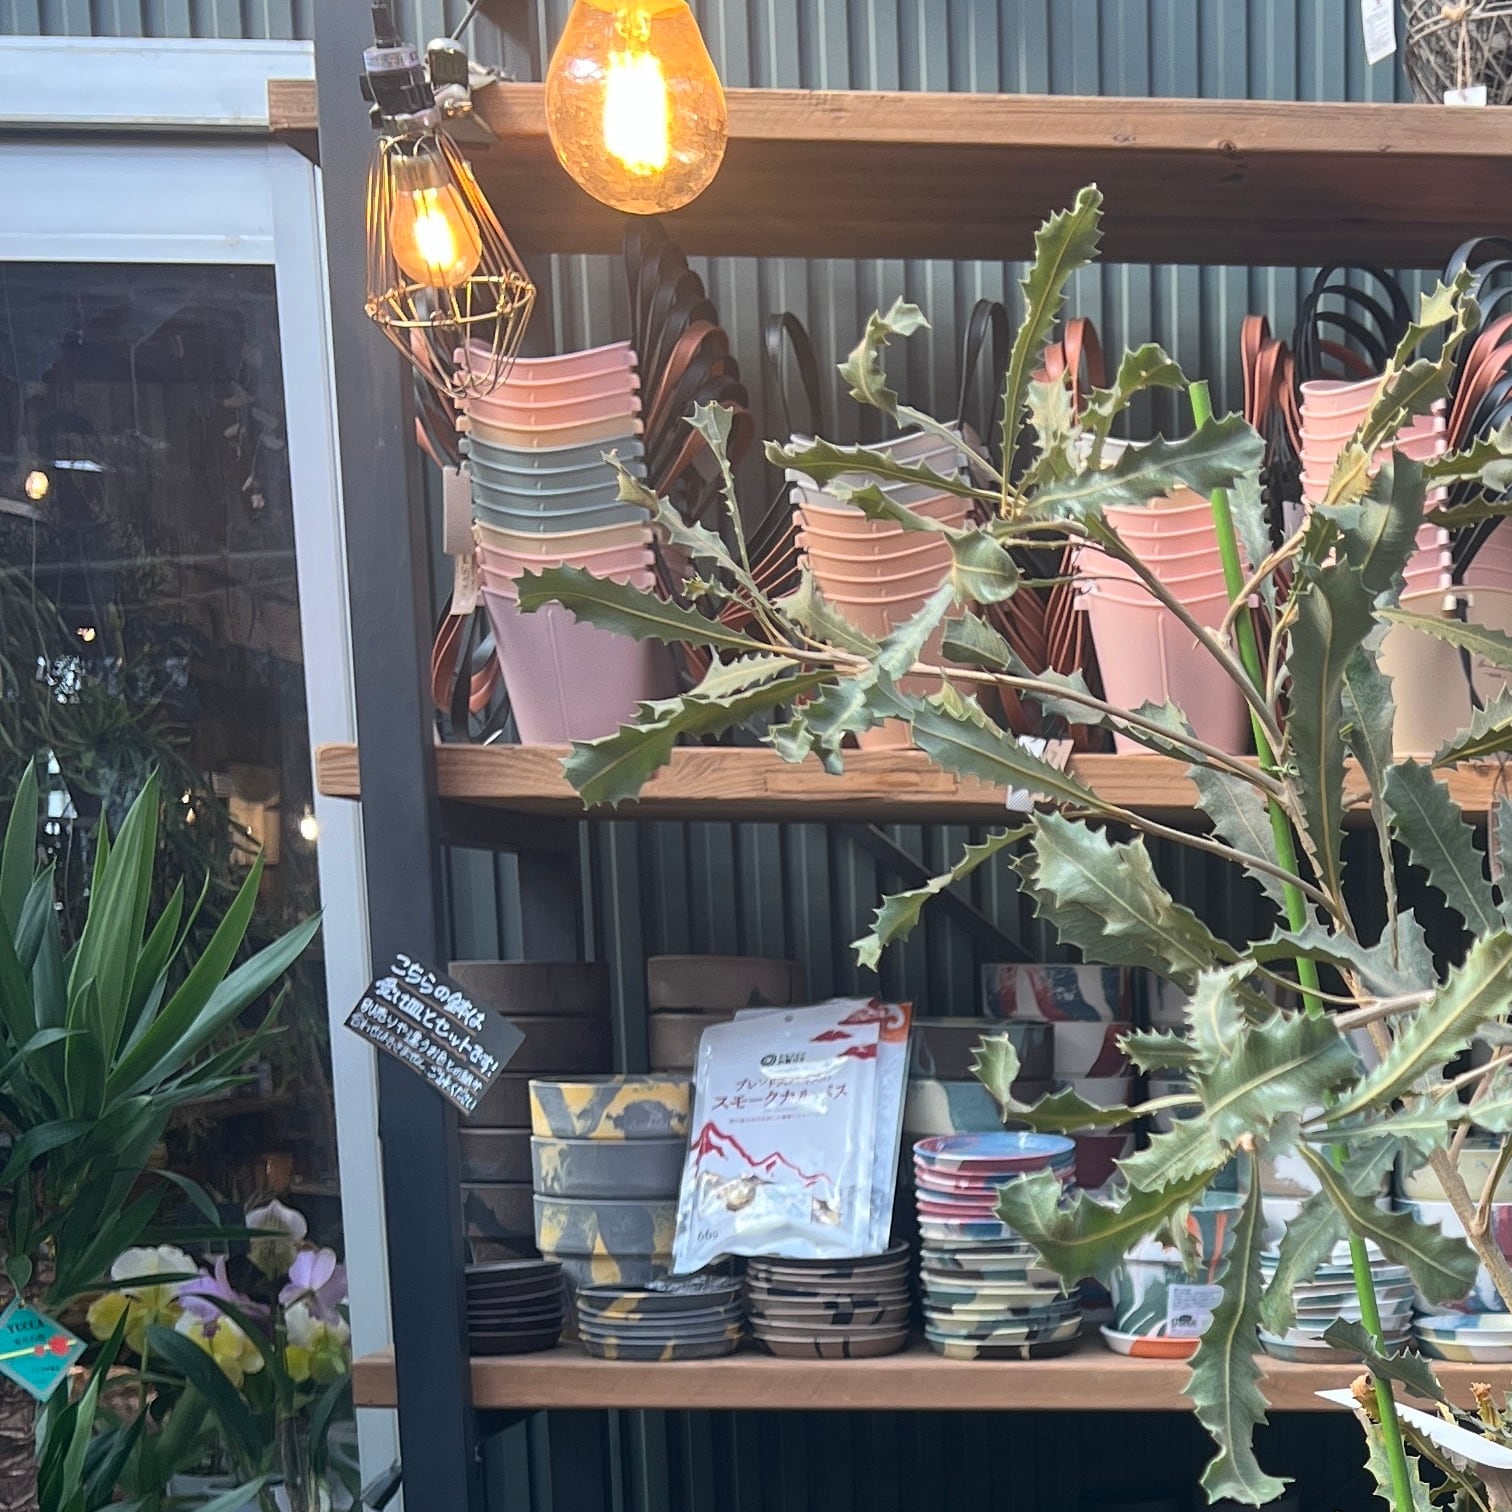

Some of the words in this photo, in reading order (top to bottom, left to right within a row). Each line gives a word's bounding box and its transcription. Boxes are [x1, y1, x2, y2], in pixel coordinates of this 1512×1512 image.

[390, 953, 486, 1031] こちらの鉢は
